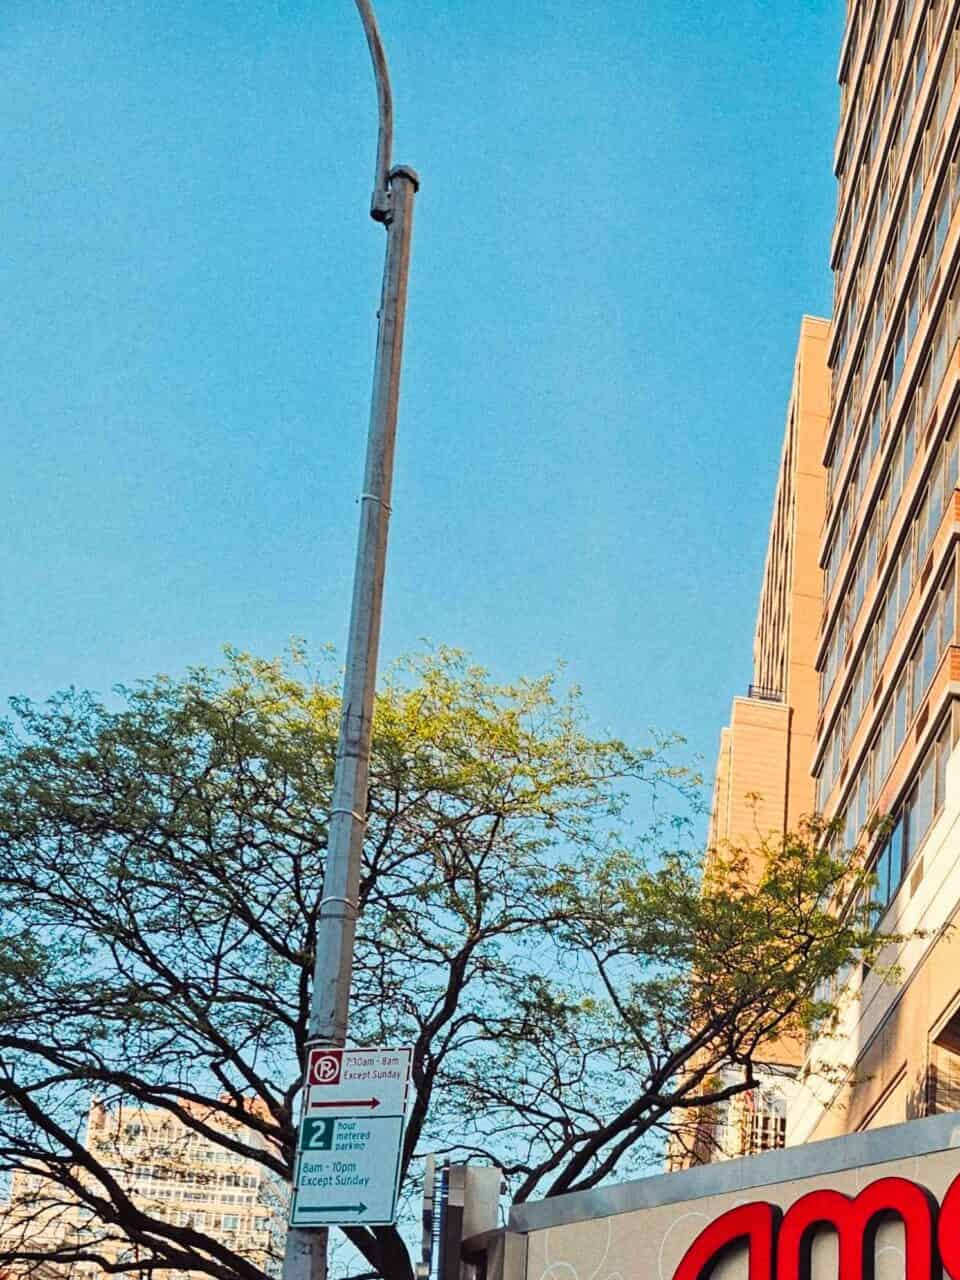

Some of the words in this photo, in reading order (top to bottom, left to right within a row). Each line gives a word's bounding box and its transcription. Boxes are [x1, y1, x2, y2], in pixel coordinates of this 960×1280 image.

[382, 1056, 400, 1066] 8am
[344, 1071, 370, 1080] Except
[373, 1069, 401, 1080] Sunday
[337, 1121, 356, 1130] hour
[308, 1120, 326, 1148] 2
[336, 1131, 370, 1140] metered
[302, 1162, 322, 1173] 8am
[332, 1161, 357, 1173] 10pm
[301, 1175, 333, 1188] Except
[335, 1174, 370, 1187] Sunday
